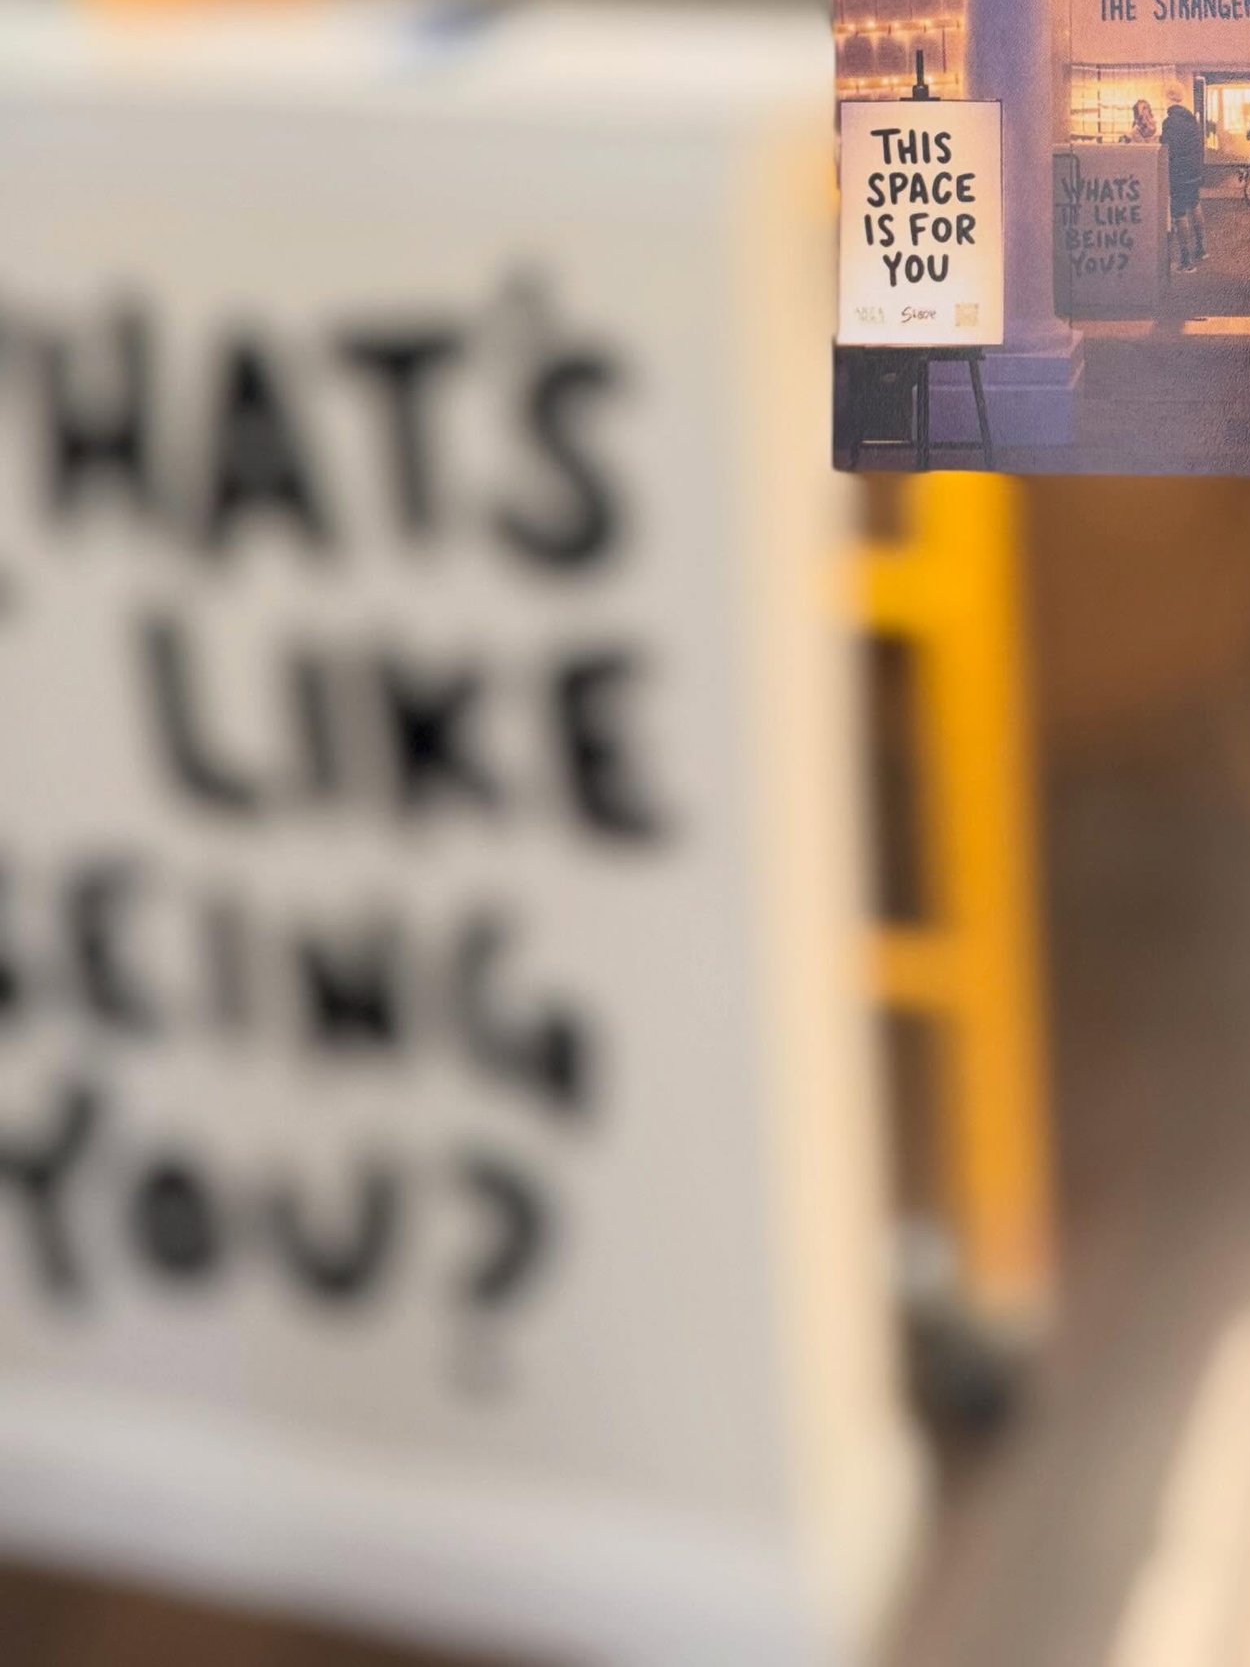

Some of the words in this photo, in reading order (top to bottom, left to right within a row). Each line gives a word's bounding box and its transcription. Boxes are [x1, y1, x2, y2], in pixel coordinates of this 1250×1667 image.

[870, 128, 952, 165] THIS
[867, 172, 976, 208] SPACE
[864, 214, 895, 247] IS
[909, 212, 976, 246] FOR
[1094, 204, 1142, 226] LIKE
[1065, 229, 1134, 251] BEING
[882, 251, 949, 287] YOU
